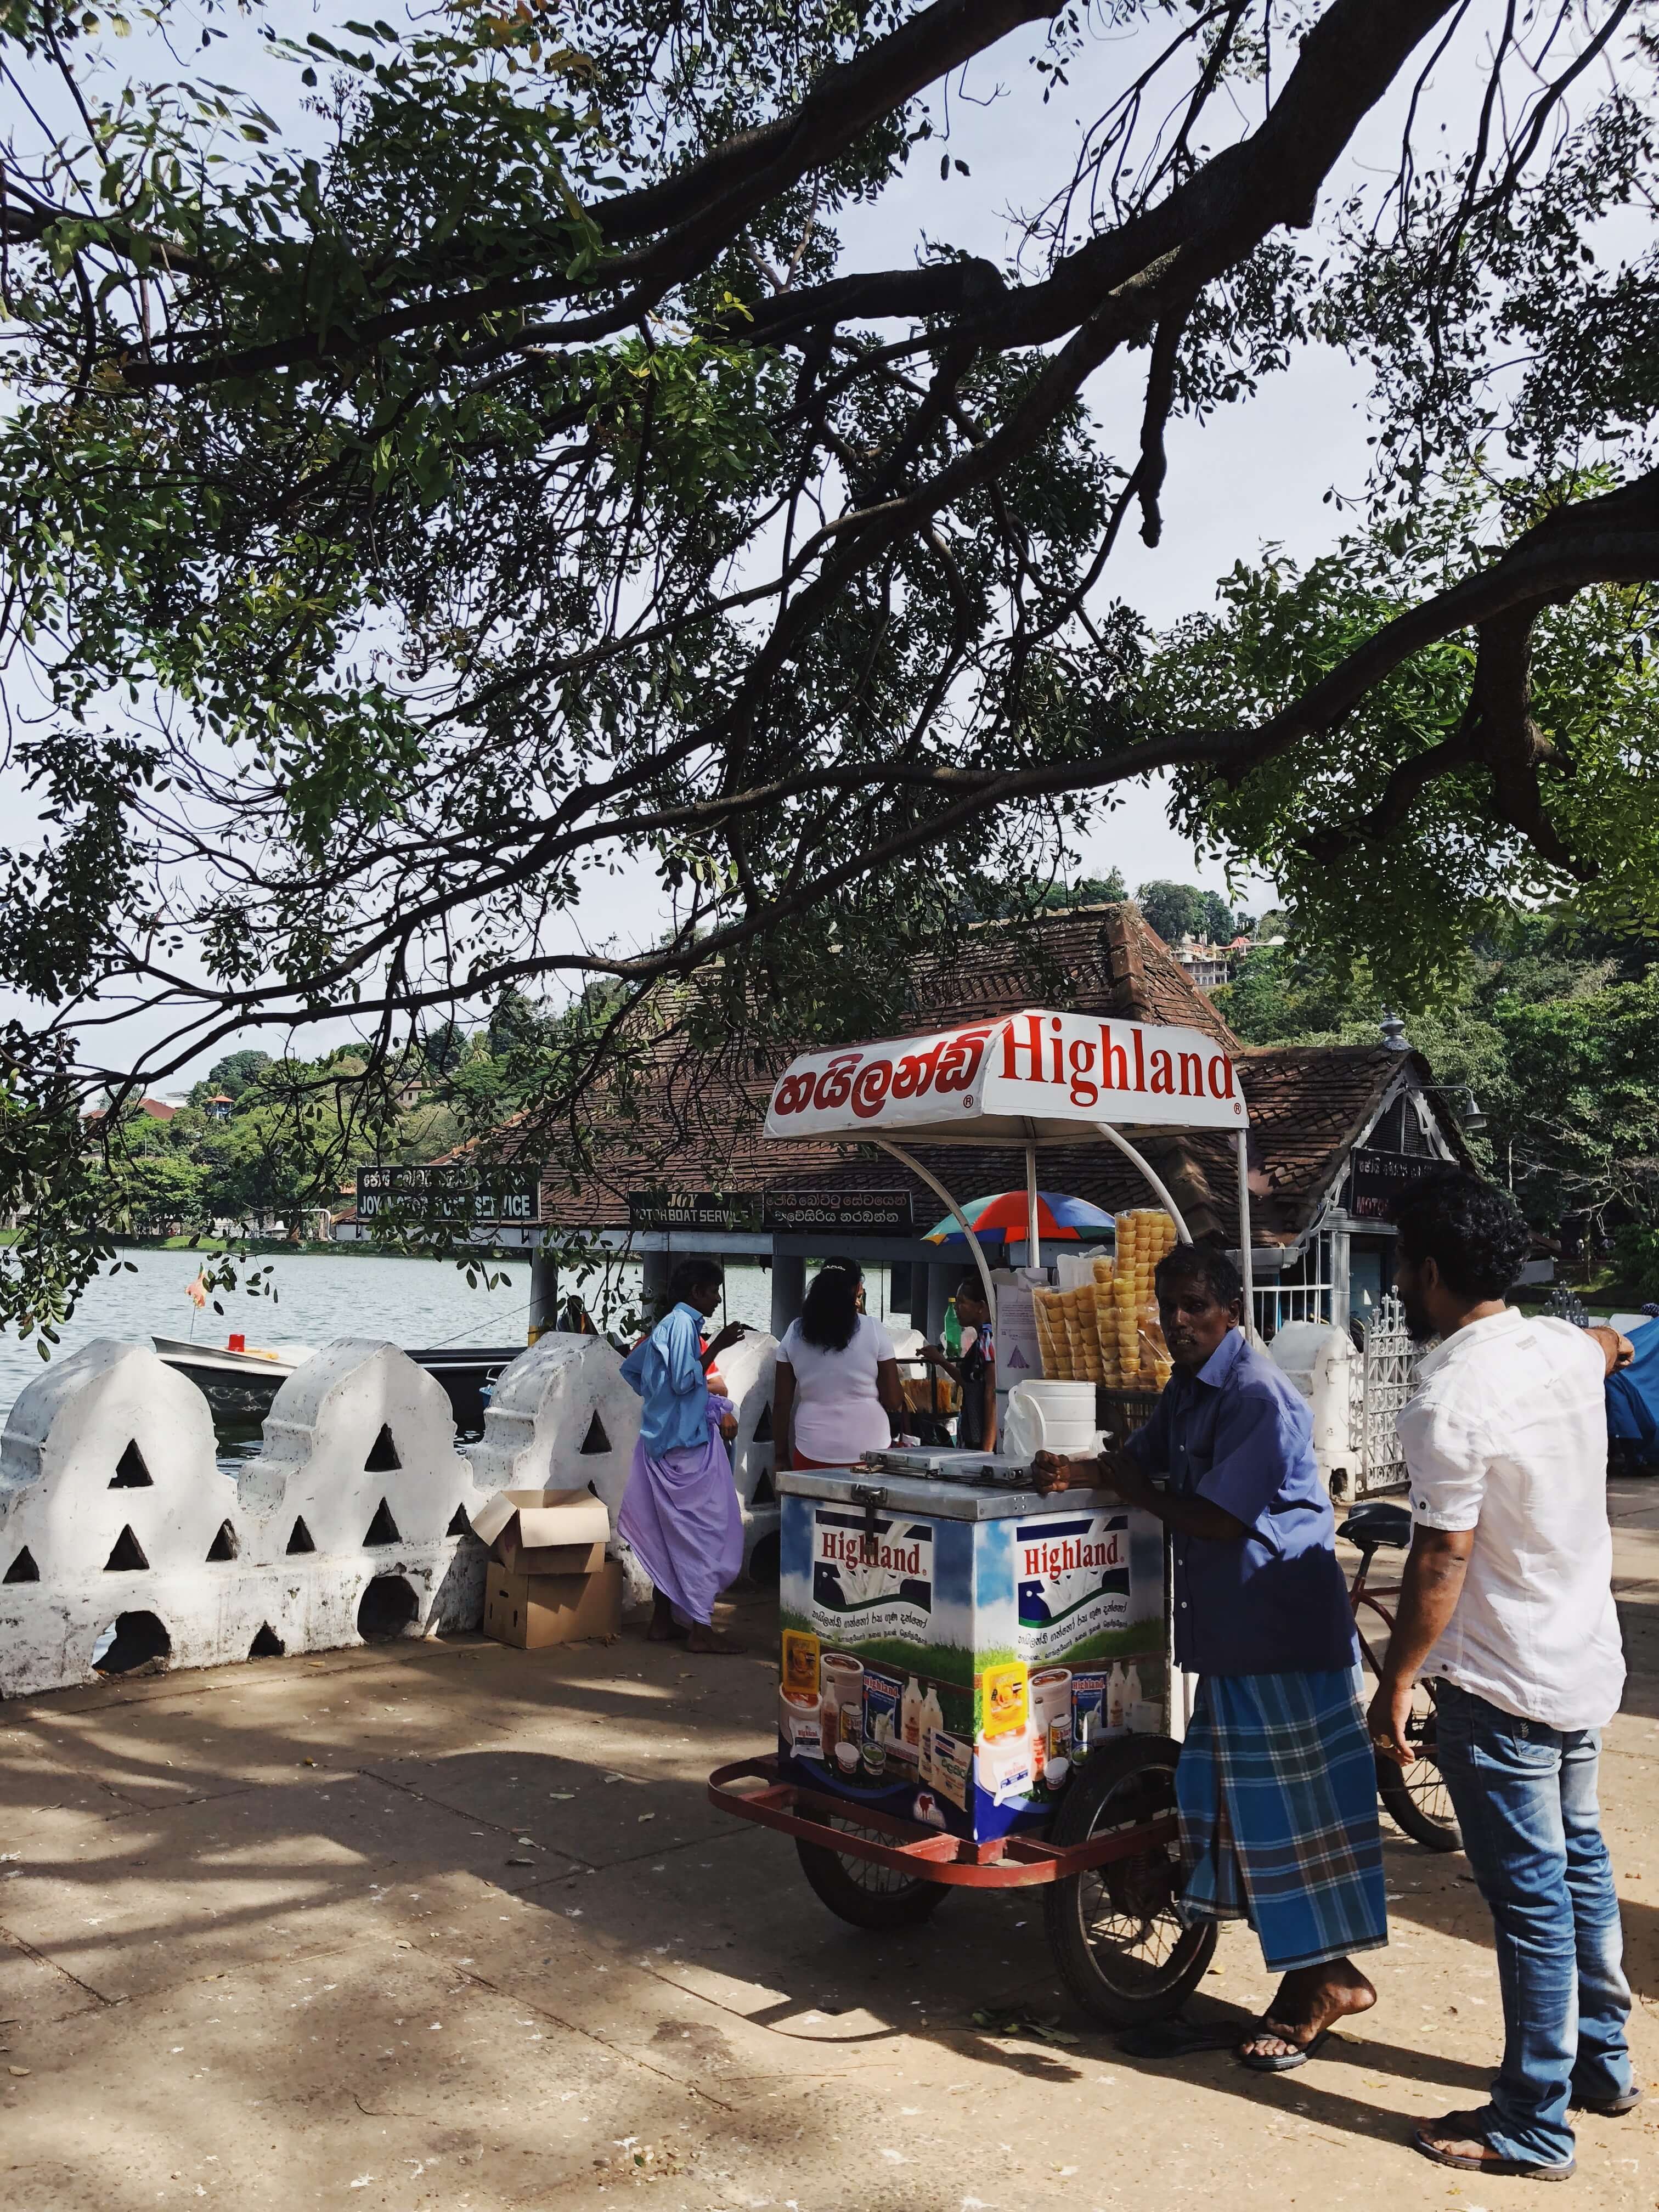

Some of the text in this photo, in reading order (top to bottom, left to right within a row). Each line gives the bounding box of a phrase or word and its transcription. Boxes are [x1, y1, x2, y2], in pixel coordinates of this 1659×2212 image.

[998, 1015, 1236, 1107] Highland
[774, 1030, 992, 1118] හයිලන්ඩ්
[360, 1195, 382, 1215] JOY
[667, 1193, 698, 1207] JOY
[668, 1209, 698, 1222] BOAT
[821, 1531, 921, 1575] Highland
[1024, 1533, 1119, 1581] Highland
[863, 1675, 900, 1699] Highland
[1072, 1677, 1106, 1692] Highland
